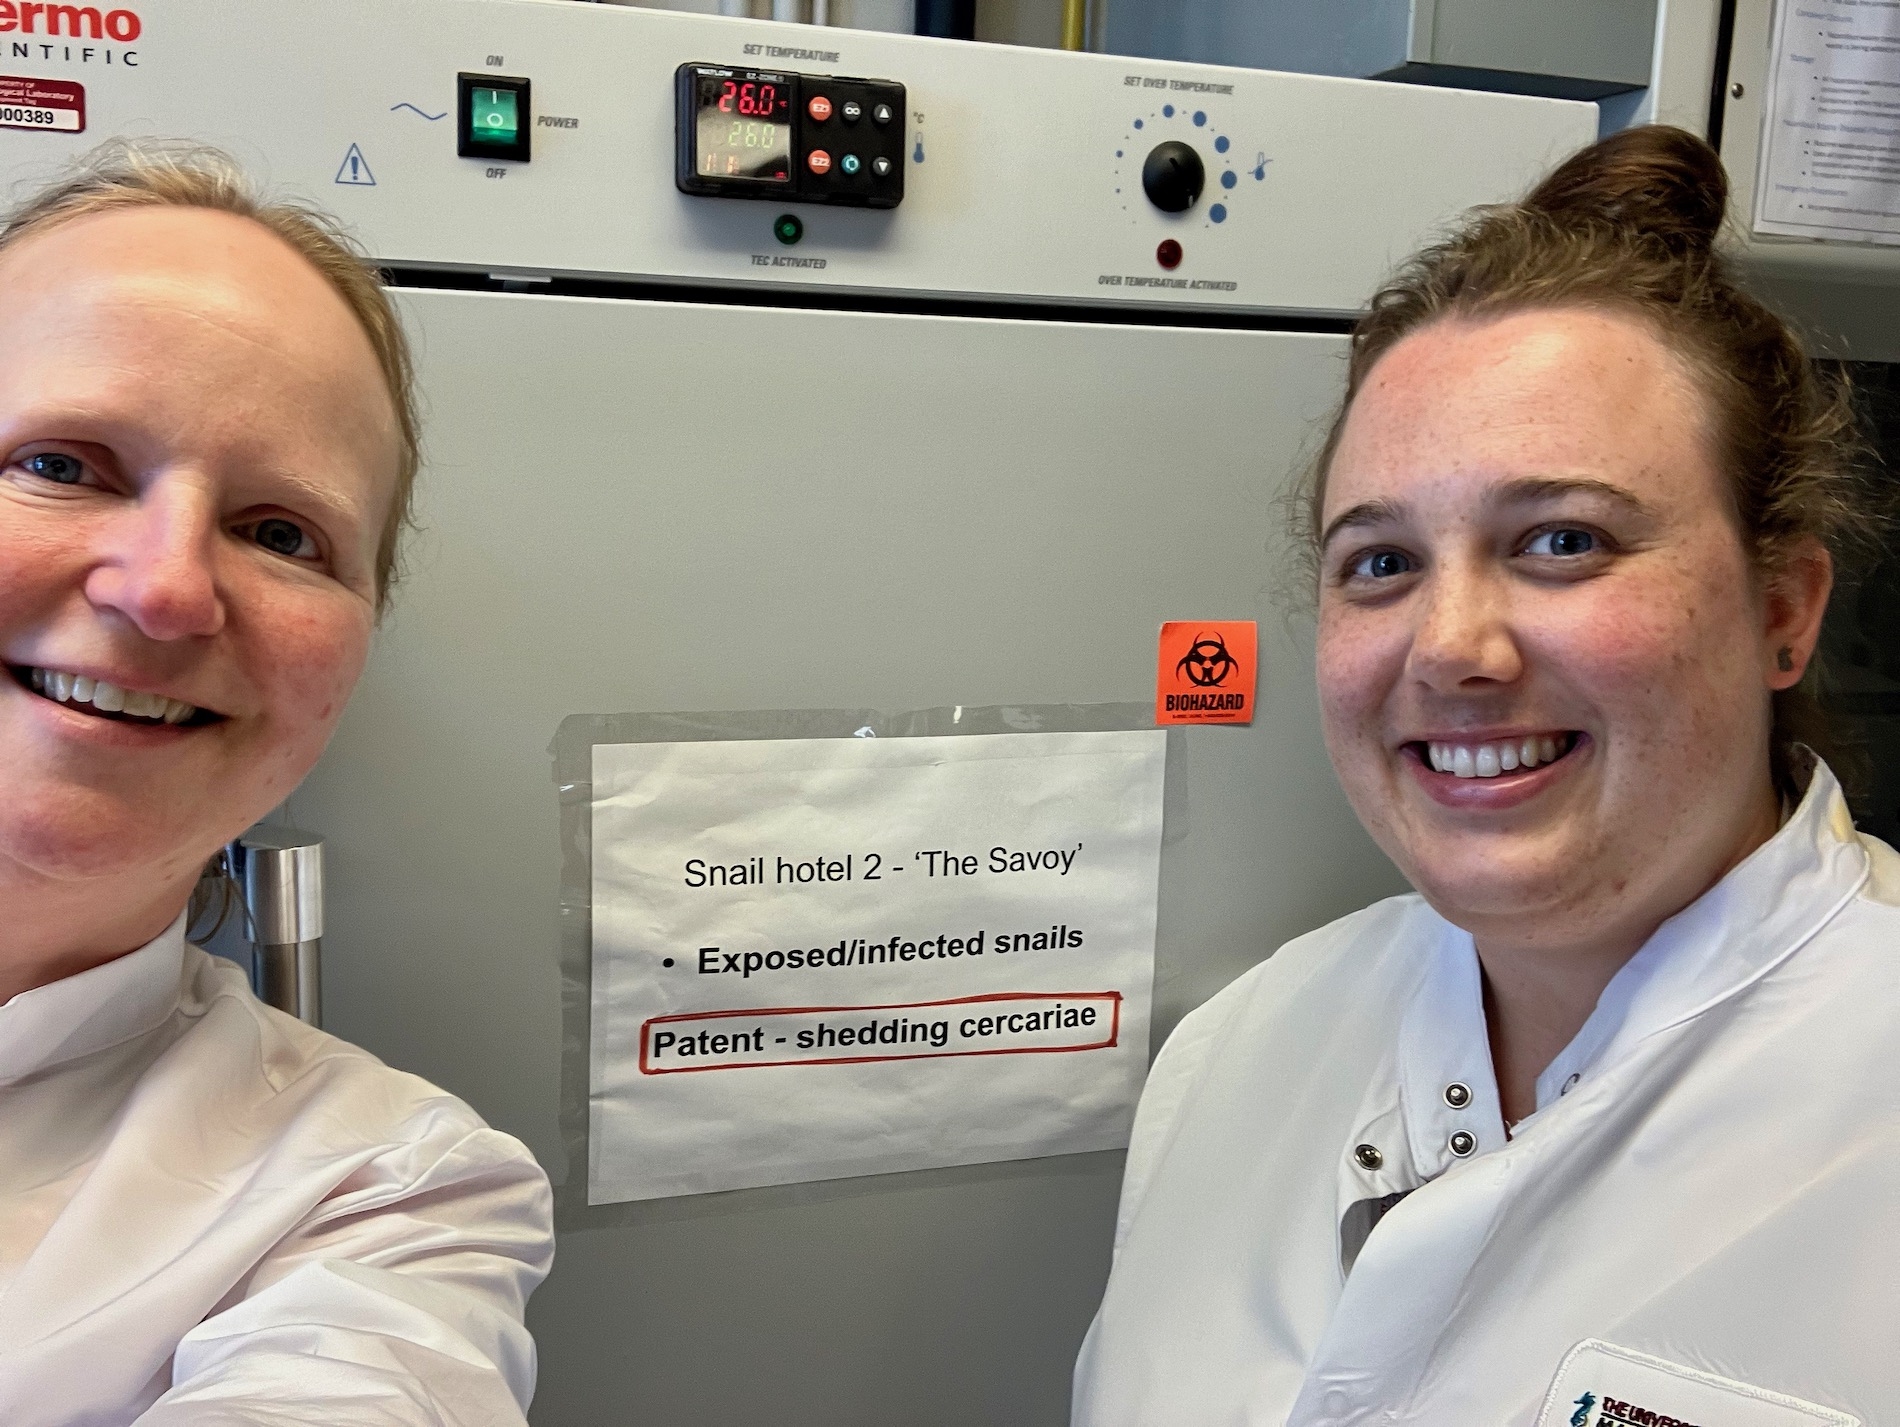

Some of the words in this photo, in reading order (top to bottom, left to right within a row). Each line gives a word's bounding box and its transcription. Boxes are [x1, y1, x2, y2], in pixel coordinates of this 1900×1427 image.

[0, 42, 138, 66] NTIFIC
[485, 55, 504, 67] ON
[743, 43, 764, 55] SET
[765, 45, 840, 62] TEMPERATURE
[1123, 76, 1142, 86] SET
[1143, 78, 1167, 89] OVER
[1169, 80, 1235, 95] TEMPERATURE
[718, 81, 775, 115] 26.0
[0, 108, 54, 124] 00389
[537, 116, 579, 128] POWER
[486, 167, 507, 179] OFF
[751, 254, 770, 266] TEC
[771, 256, 827, 269] ACTIVATED
[1098, 275, 1122, 286] OVER
[1124, 276, 1188, 289] TEMPERATURE
[1189, 280, 1238, 291] ACTIVATED
[1165, 693, 1245, 711] BIOHAZARD
[685, 857, 764, 888] Snail
[777, 854, 852, 883] hotel
[863, 853, 882, 880] 2
[698, 931, 985, 978] Exposed/infected
[994, 924, 1084, 954] snails
[653, 1026, 765, 1058] Patent
[796, 1018, 950, 1049] shedding
[959, 1003, 1097, 1040] cercariae
[1603, 1396, 1630, 1418] THE
